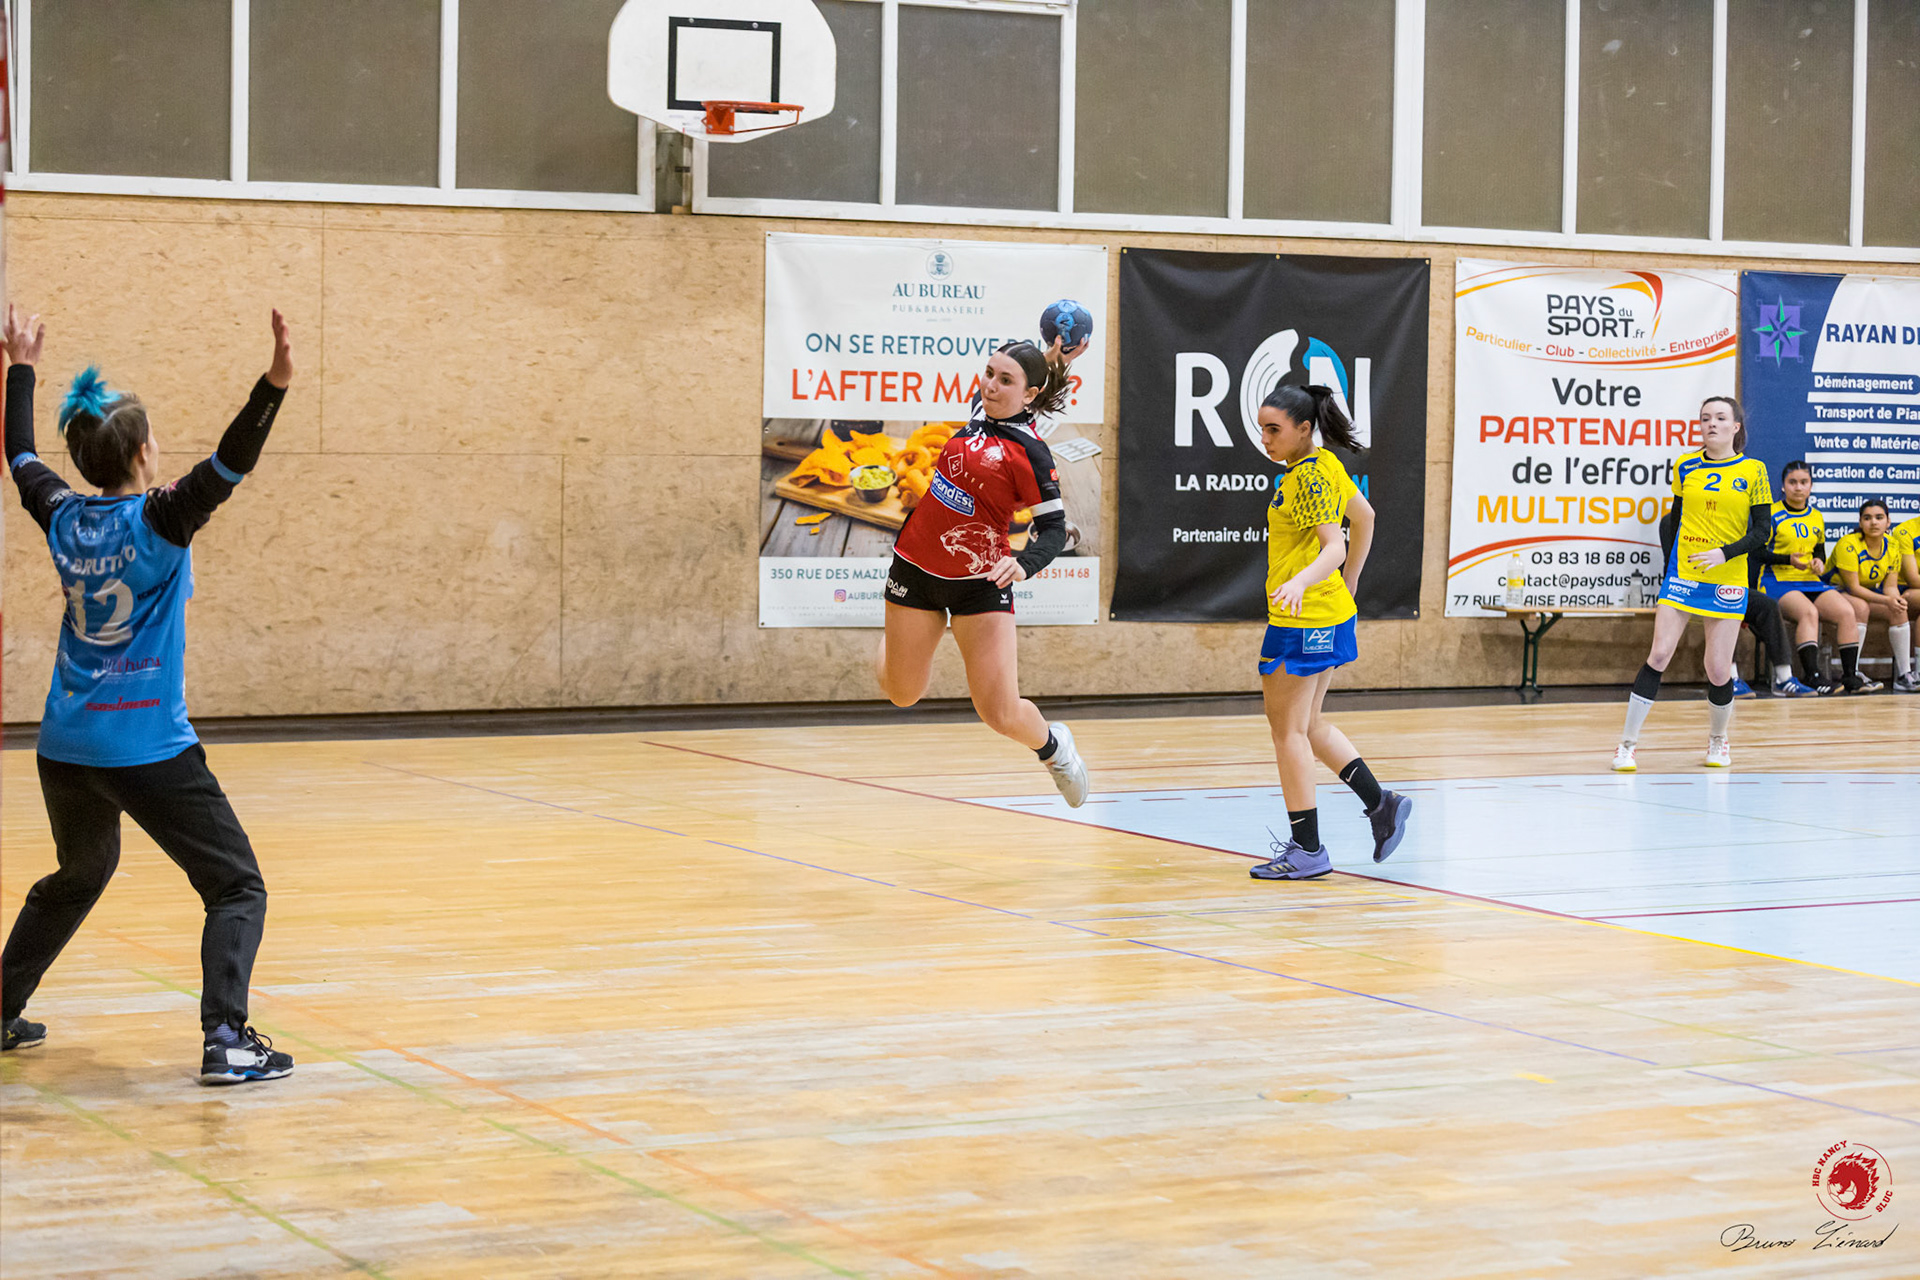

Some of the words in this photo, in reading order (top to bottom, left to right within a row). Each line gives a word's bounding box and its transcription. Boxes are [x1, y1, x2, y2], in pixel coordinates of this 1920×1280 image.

[893, 283, 915, 298] AU
[919, 283, 986, 300] BUREAU
[1546, 294, 1616, 317] PAYS
[1618, 307, 1633, 317] du
[1466, 325, 1534, 353] Particulier
[1545, 344, 1575, 358] Club
[1588, 344, 1657, 359] Collectivité
[1669, 327, 1730, 354] Entreprise
[1826, 323, 1897, 344] RAYAN
[1902, 326, 1920, 346] D
[806, 333, 841, 353] ON
[849, 334, 875, 354] SE
[882, 335, 1000, 357] RETROUVE
[792, 368, 923, 403] L'AFTER
[1552, 377, 1642, 407] Votre
[1814, 375, 1914, 392] Déménagement
[1814, 405, 1874, 421] Transport
[1877, 406, 1893, 420] de
[1480, 415, 1704, 447] PARTENAIRE
[1814, 435, 1849, 449] Vente
[1852, 436, 1867, 449] de
[1512, 456, 1552, 484] de
[1565, 457, 1674, 486] l'effort
[1811, 465, 1865, 479] Location
[1869, 466, 1884, 479] de
[1887, 466, 1920, 480] Cami
[1175, 474, 1201, 491] LA
[1206, 473, 1269, 491] RADIO
[1703, 472, 1722, 492] 2
[1886, 496, 1920, 510] Entre
[1173, 527, 1240, 543] Partenaire
[1243, 527, 1260, 543] du
[1791, 522, 1809, 539] 10
[1531, 551, 1553, 565] 03
[1558, 551, 1579, 565] 83
[1585, 551, 1601, 565] 18
[1606, 551, 1625, 565] 68
[1630, 551, 1651, 565] 06
[771, 568, 793, 580] 350
[796, 568, 822, 580] RUE
[825, 568, 849, 580] DES
[1036, 568, 1049, 579] 83
[1051, 568, 1061, 579] 51
[1065, 568, 1074, 579] 14
[1077, 568, 1090, 579] 68
[1869, 564, 1880, 580] 6
[1718, 586, 1744, 596] cora
[1453, 594, 1469, 606] 77
[1524, 595, 1556, 606] AISE
[1560, 594, 1614, 606] PASCAL
[67, 578, 134, 646] 12
[1307, 629, 1332, 643] AZ
